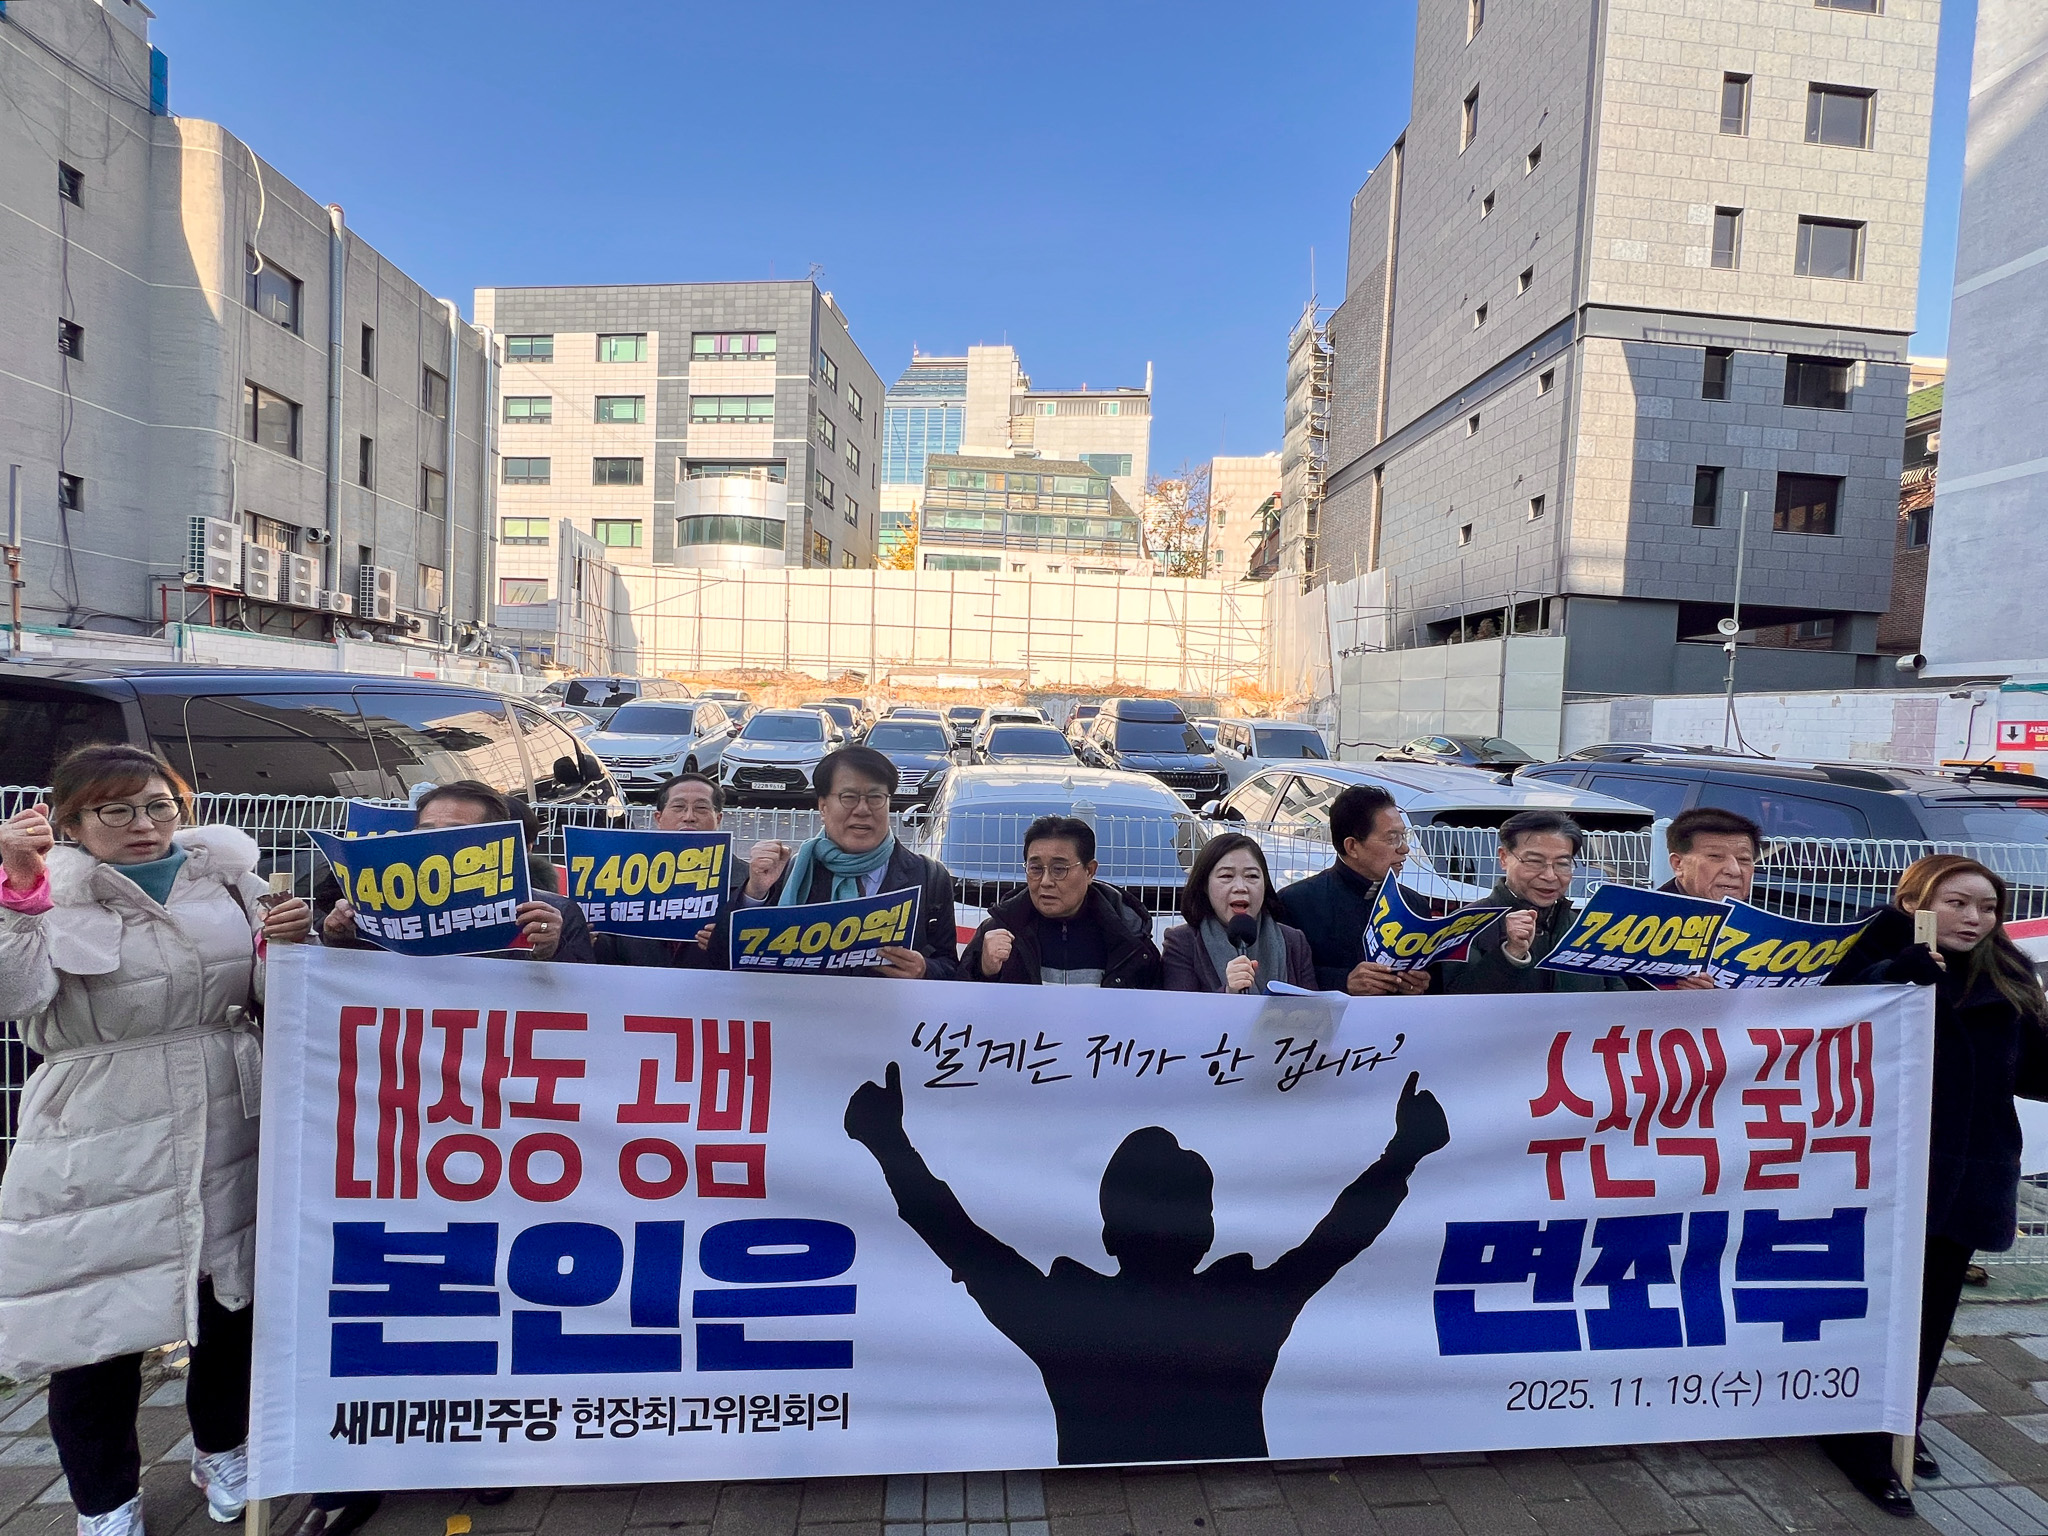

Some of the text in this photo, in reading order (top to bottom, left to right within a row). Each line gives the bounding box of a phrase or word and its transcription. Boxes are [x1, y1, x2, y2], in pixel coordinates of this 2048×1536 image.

[333, 837, 515, 910] 7,400억!
[571, 844, 725, 899] 7,400억!
[381, 915, 424, 940] 해도
[428, 898, 517, 937] 너무한다
[611, 901, 645, 921] 해도
[648, 894, 719, 921] 너무한다
[738, 899, 912, 956] 7,400억!
[739, 948, 894, 969] 해도 해도 너무한
[1549, 951, 1596, 967] 해도
[1587, 955, 1635, 972] 해도
[1570, 911, 1721, 960] 7,400억!
[1086, 1033, 1186, 1079] 제가
[1200, 1032, 1255, 1086] 한
[335, 1006, 771, 1202] 대장동 공범
[1527, 1021, 1875, 1201] 수천억 꿀꺽
[328, 1218, 857, 1378] 본인은
[1433, 1207, 1869, 1357] 면죄부
[1506, 1367, 1861, 1411] 2025. 11. 19.(수) 10:30
[329, 1391, 850, 1445] 새미래민주당 현장최고위원회의
